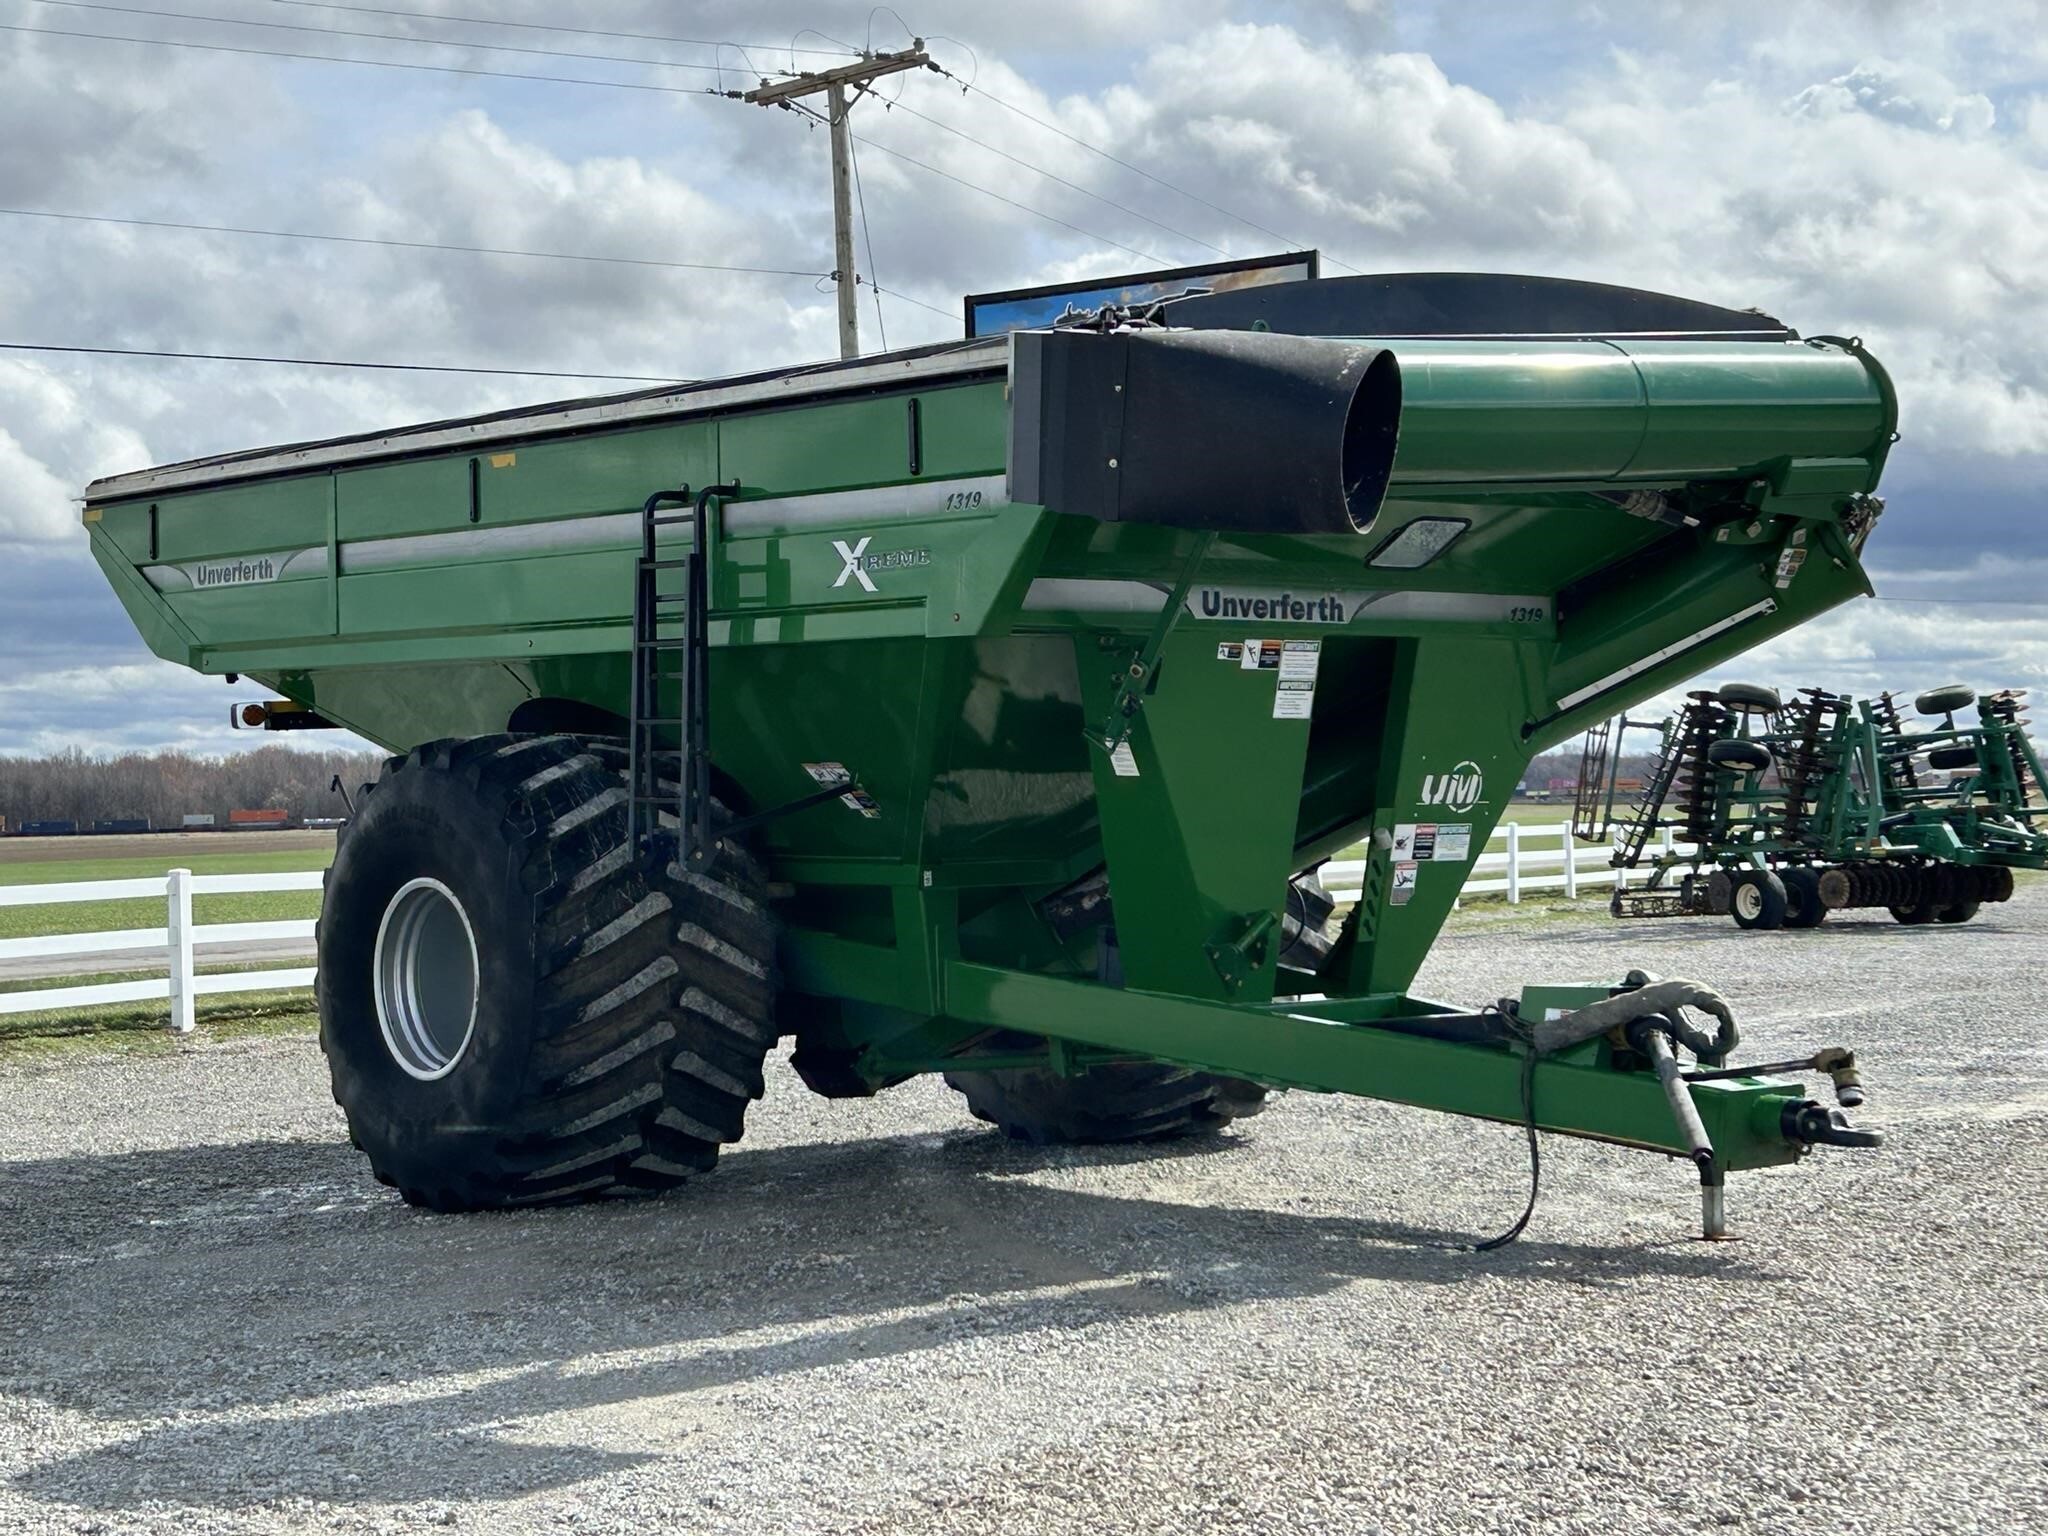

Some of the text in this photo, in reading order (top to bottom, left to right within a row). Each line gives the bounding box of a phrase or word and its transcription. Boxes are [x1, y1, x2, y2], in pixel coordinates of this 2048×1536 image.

[946, 491, 982, 511] 1319
[197, 558, 273, 585] Unverferth
[1202, 590, 1344, 622] Unverferth
[1510, 607, 1543, 622] 1319
